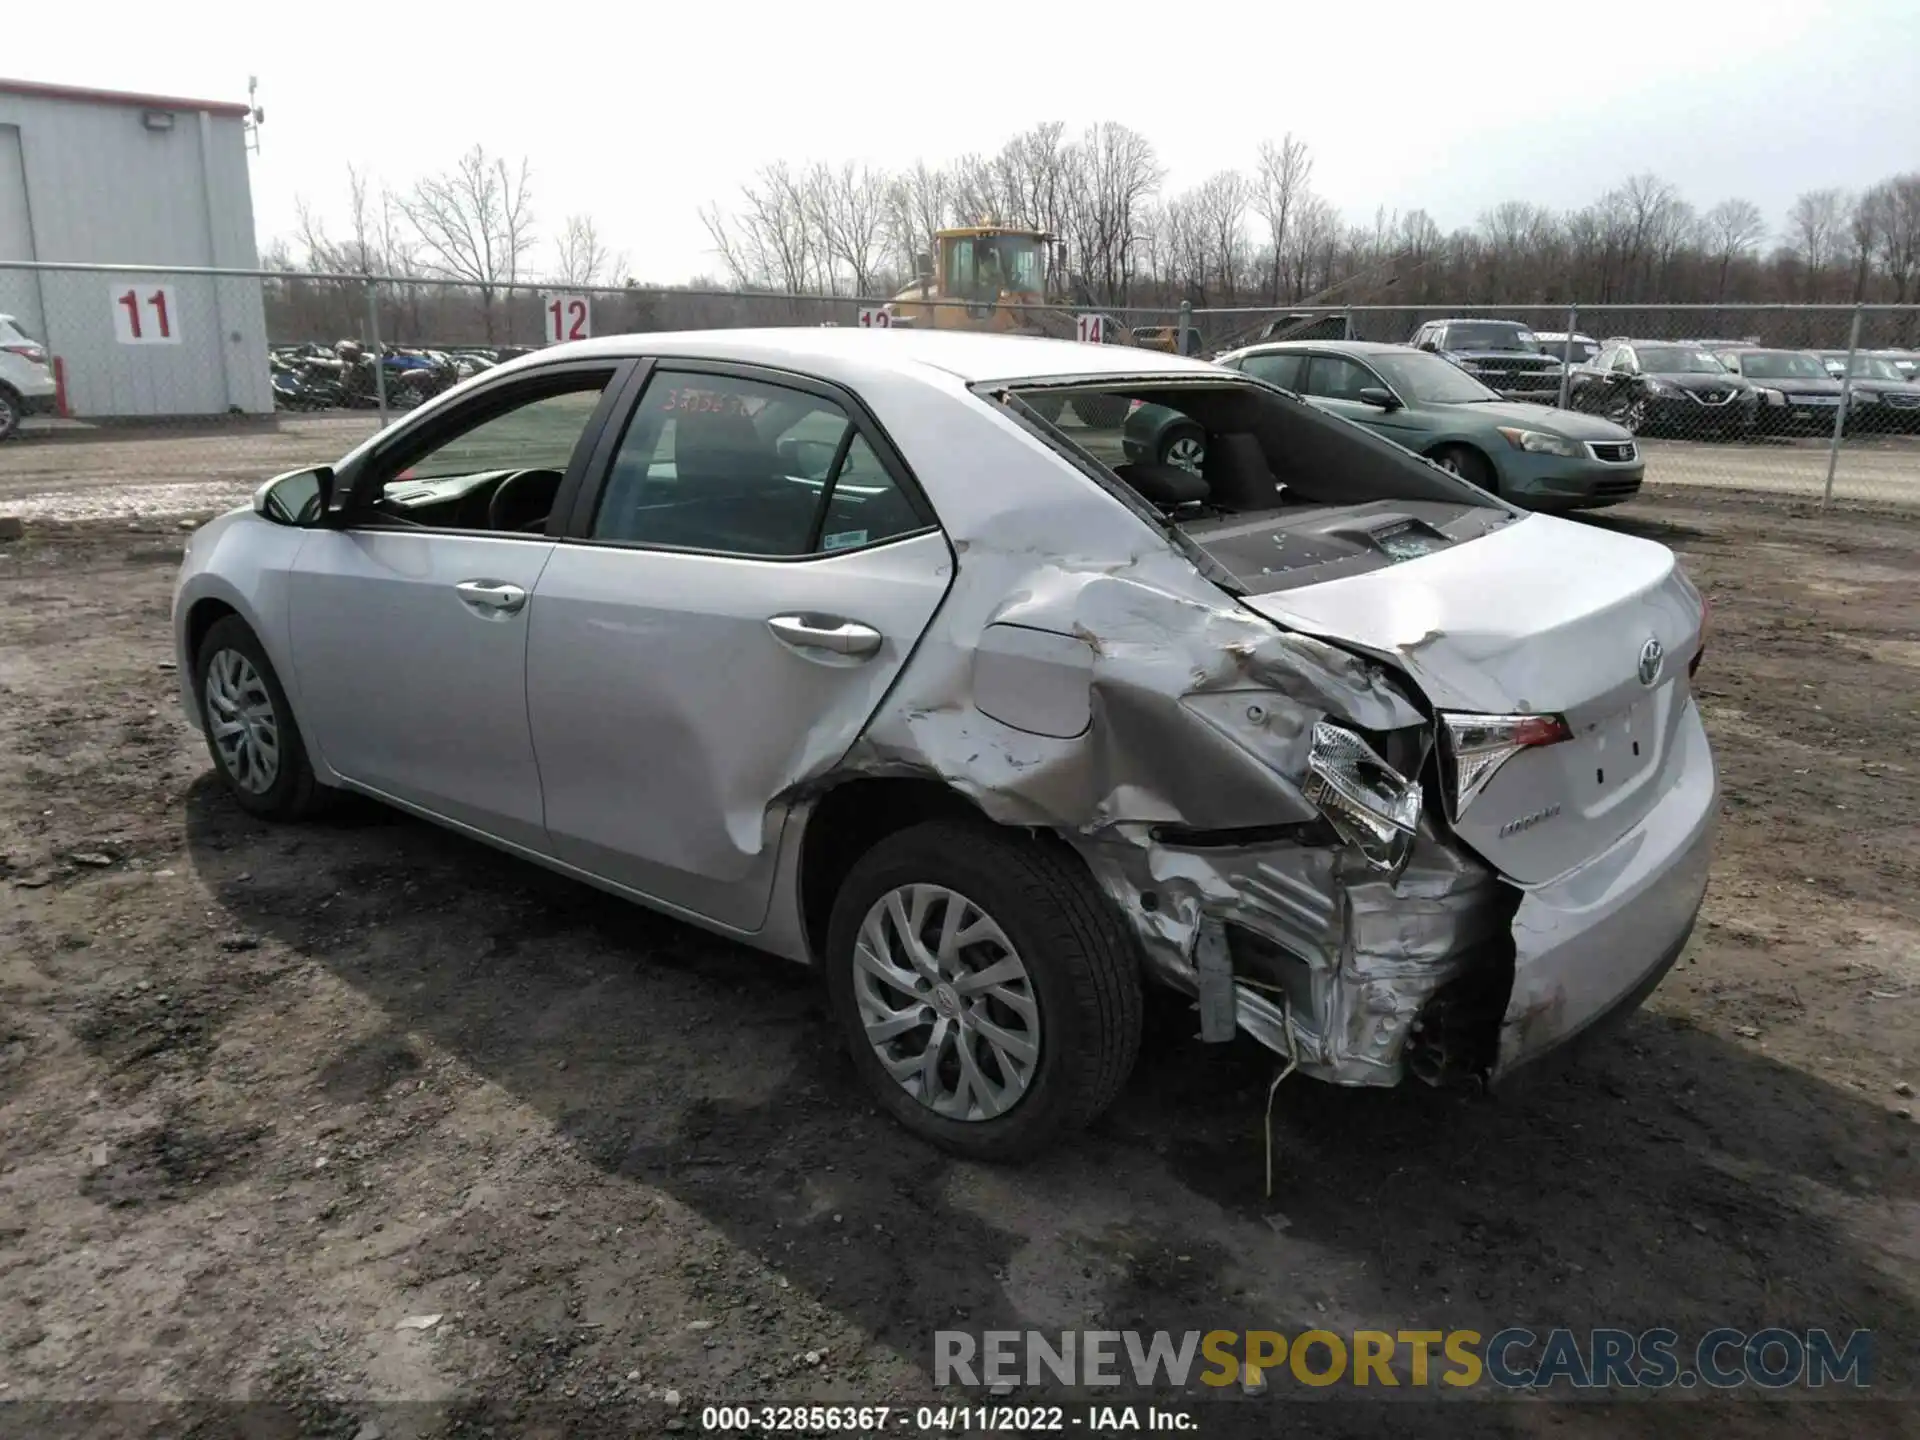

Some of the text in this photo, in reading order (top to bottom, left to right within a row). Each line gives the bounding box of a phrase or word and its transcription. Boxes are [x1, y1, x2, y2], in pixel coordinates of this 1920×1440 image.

[118, 289, 170, 337] 11
[548, 299, 587, 341] 12
[1080, 317, 1101, 342] 14
